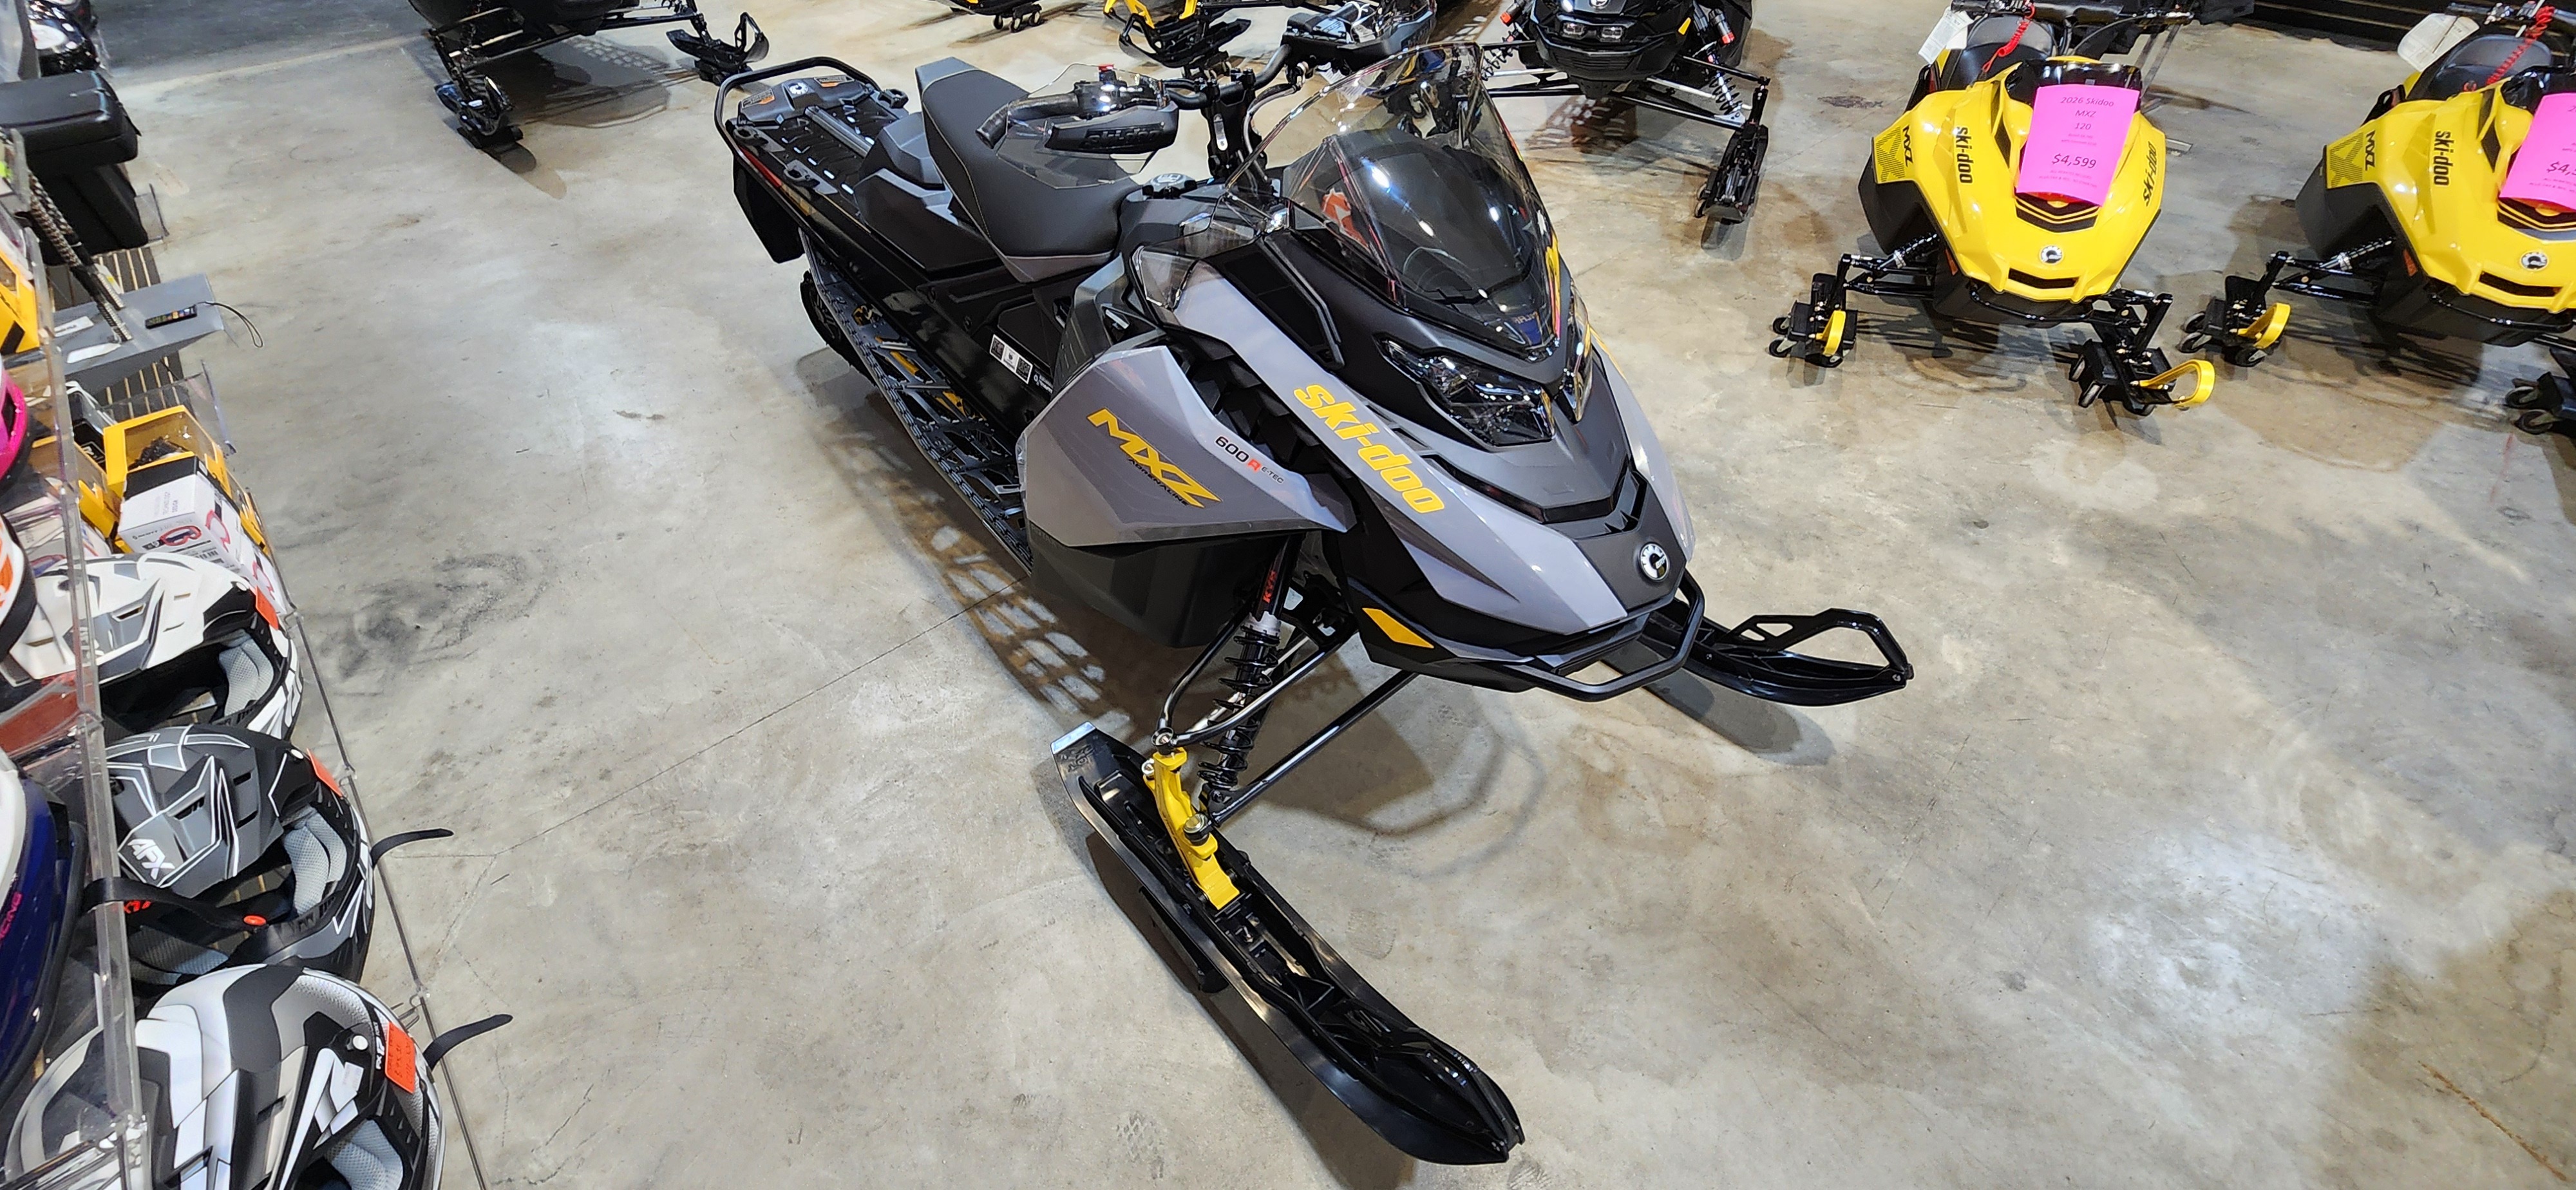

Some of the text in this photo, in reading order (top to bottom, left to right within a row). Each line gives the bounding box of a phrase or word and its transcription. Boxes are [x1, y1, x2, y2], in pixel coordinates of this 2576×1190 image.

[2086, 99, 2114, 108] Skidoo
[1902, 126, 1914, 167] MXZ
[1955, 126, 1975, 184] ski-doo
[2051, 153, 2097, 169] $4,599
[2365, 129, 2376, 172] MXZ
[2432, 130, 2455, 186] ski-doo
[2143, 140, 2157, 207] ski-doo
[1086, 408, 1222, 509] MXZ
[1293, 384, 1445, 514] ski-doo
[1128, 457, 1189, 507] ADRENALINE
[1261, 466, 1284, 484] E-TEC
[128, 838, 176, 880] AFX
